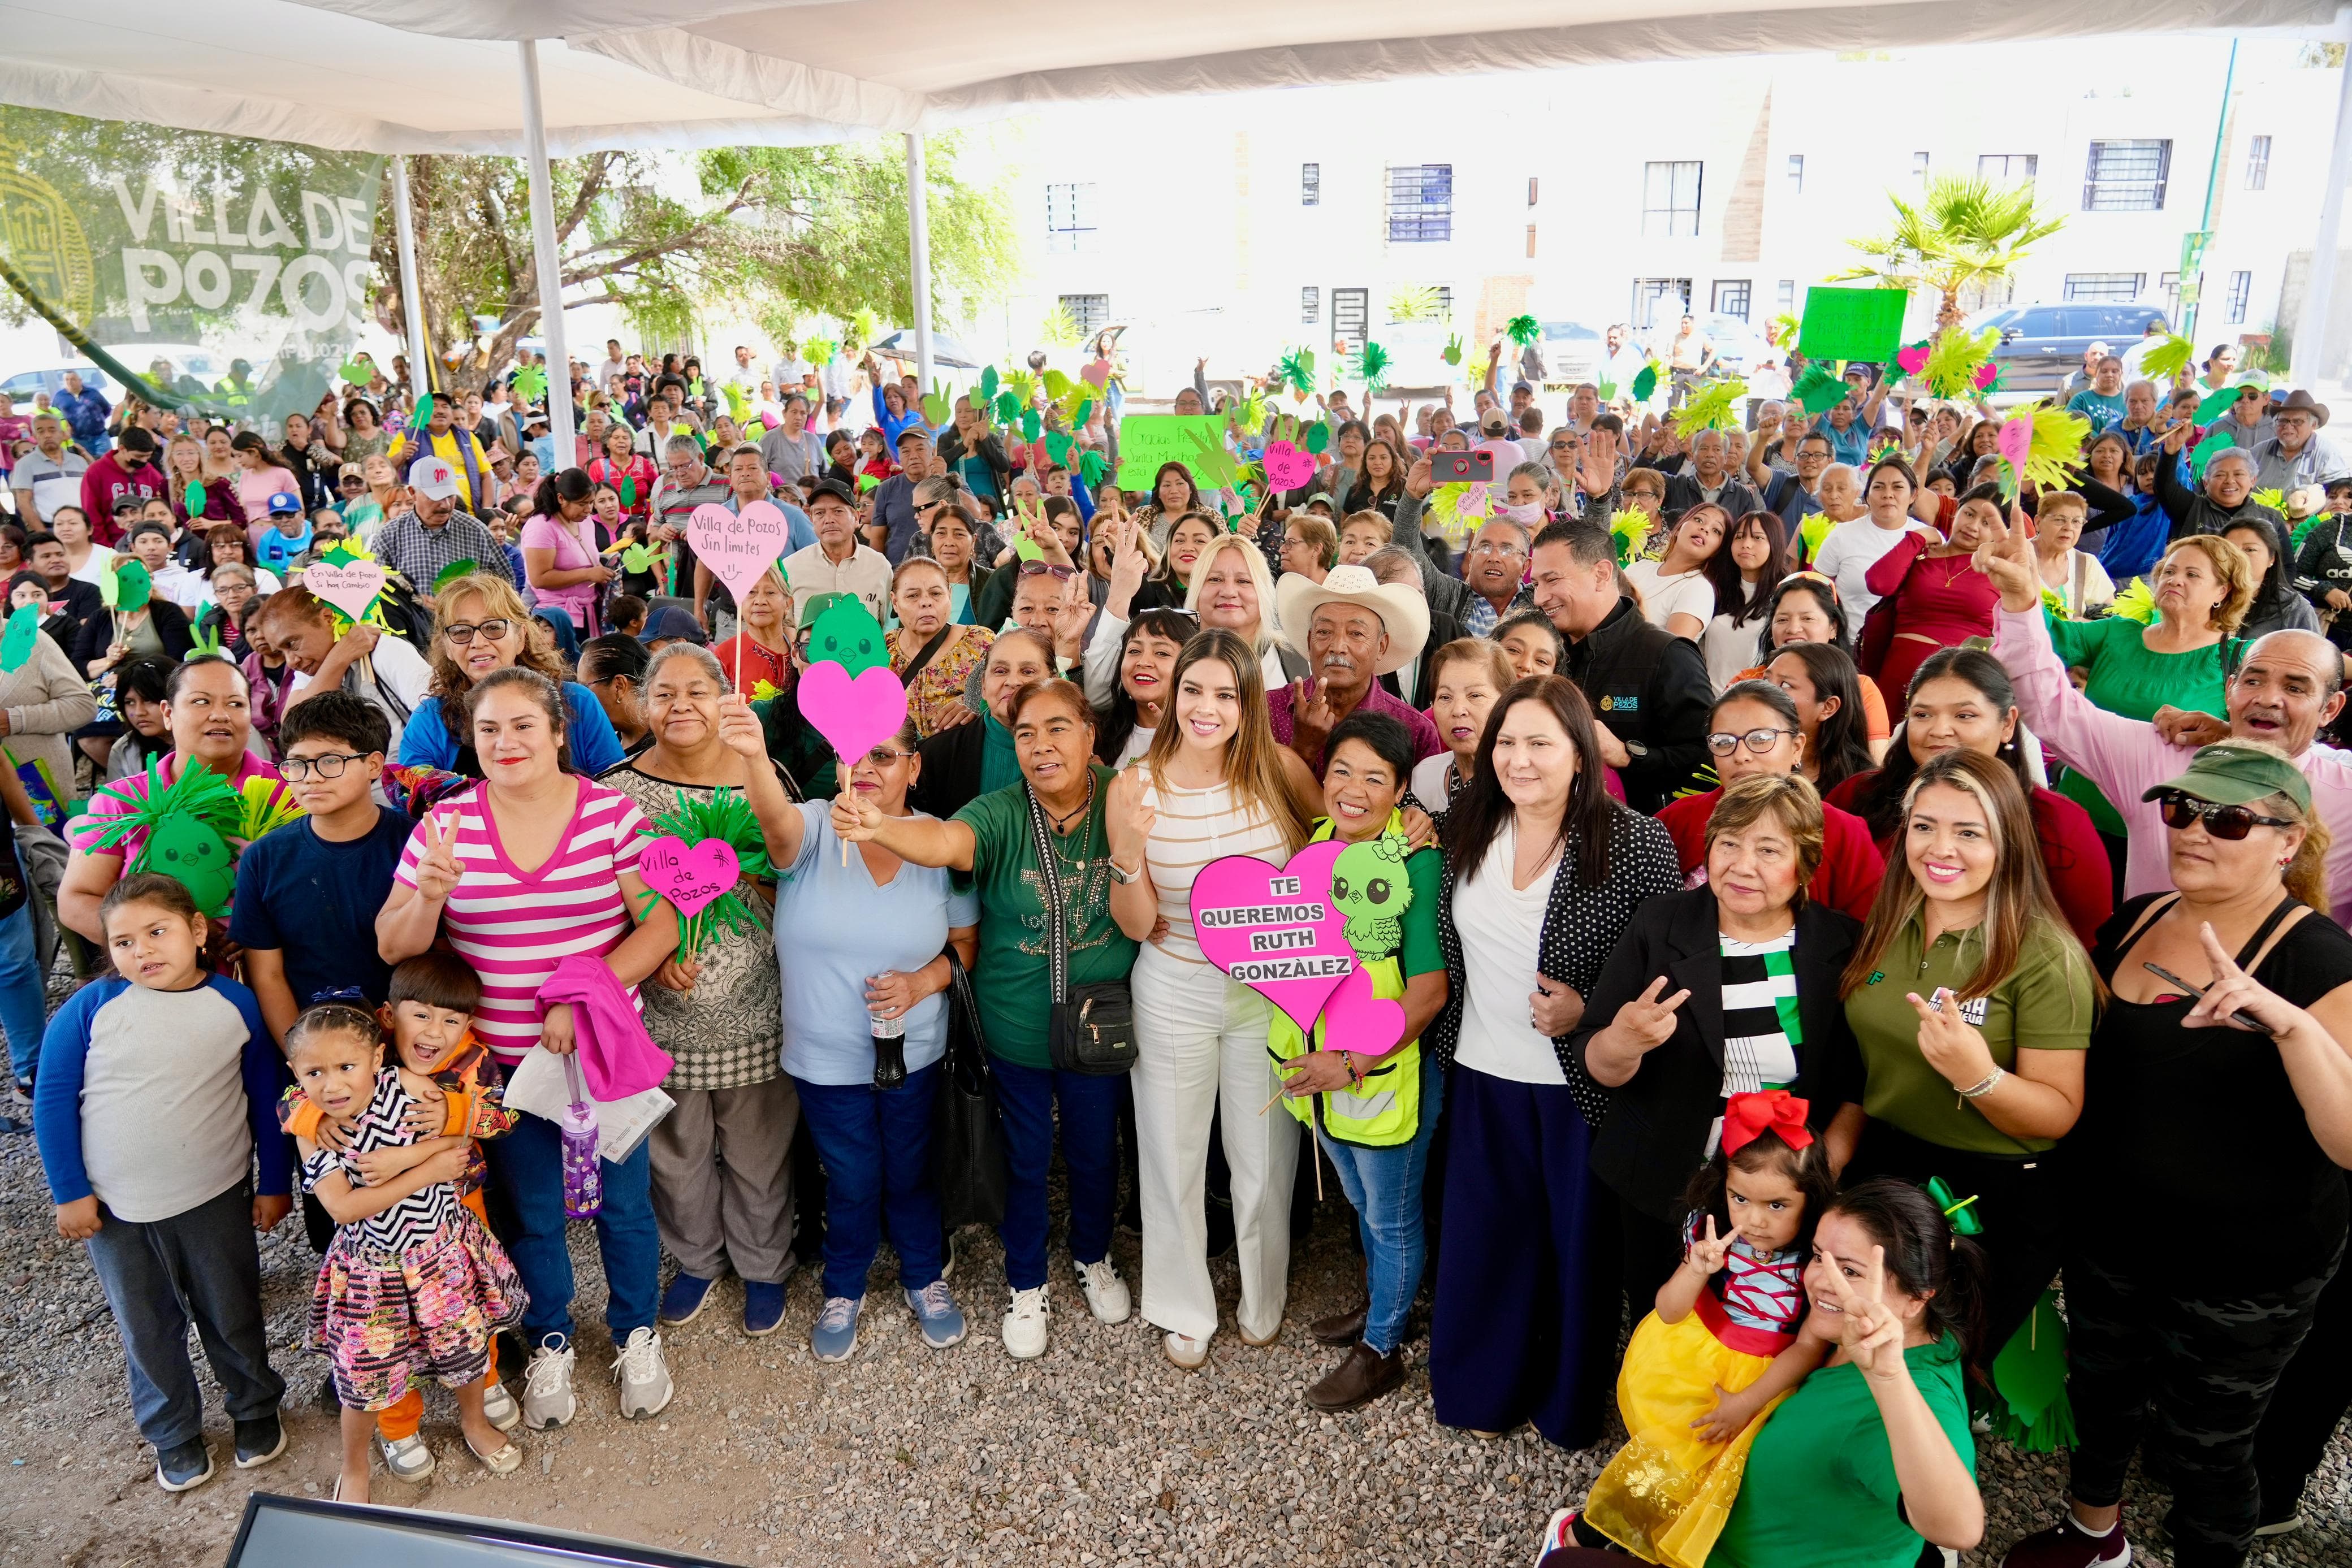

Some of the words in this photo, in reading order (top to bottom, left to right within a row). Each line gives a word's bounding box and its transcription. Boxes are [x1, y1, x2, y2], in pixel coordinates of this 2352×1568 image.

[113, 177, 302, 249] VILLA
[300, 190, 371, 255] DE
[1130, 421, 1171, 445] Gracias
[1126, 448, 1152, 464] Santa
[1270, 444, 1291, 457] Villa
[1277, 462, 1290, 474] de
[693, 515, 721, 533] Villa
[728, 519, 744, 535] de
[748, 518, 781, 536] Pozos
[701, 534, 720, 551] Sin
[725, 535, 760, 556] limites
[310, 569, 324, 578] En
[641, 850, 678, 872] Villa
[674, 868, 695, 883] de
[669, 882, 721, 903] Pozos
[1270, 878, 1300, 895] TE
[1201, 904, 1324, 927] QUEREMOS
[1253, 930, 1314, 951] RUTH
[1231, 958, 1350, 981] GONZÀLEZ
